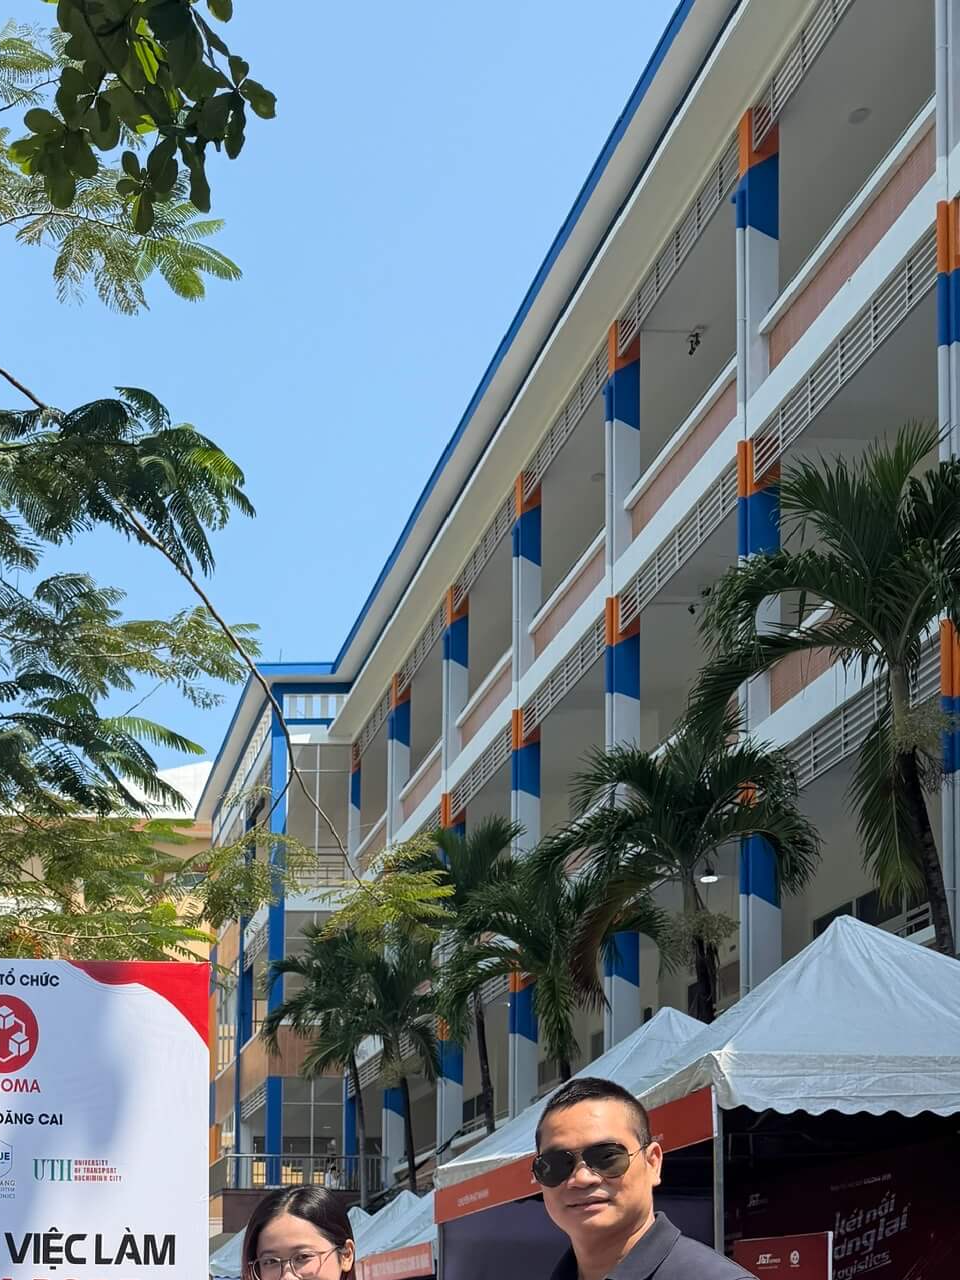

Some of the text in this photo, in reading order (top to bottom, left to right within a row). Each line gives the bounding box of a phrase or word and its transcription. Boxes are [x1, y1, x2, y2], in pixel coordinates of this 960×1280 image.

[0, 968, 16, 986] TỔ
[20, 971, 60, 987] CHỨC
[38, 1113, 63, 1126] CAI
[33, 1158, 72, 1181] UTH
[4, 1227, 89, 1270] VIỆC
[95, 1227, 176, 1266] LÀM
